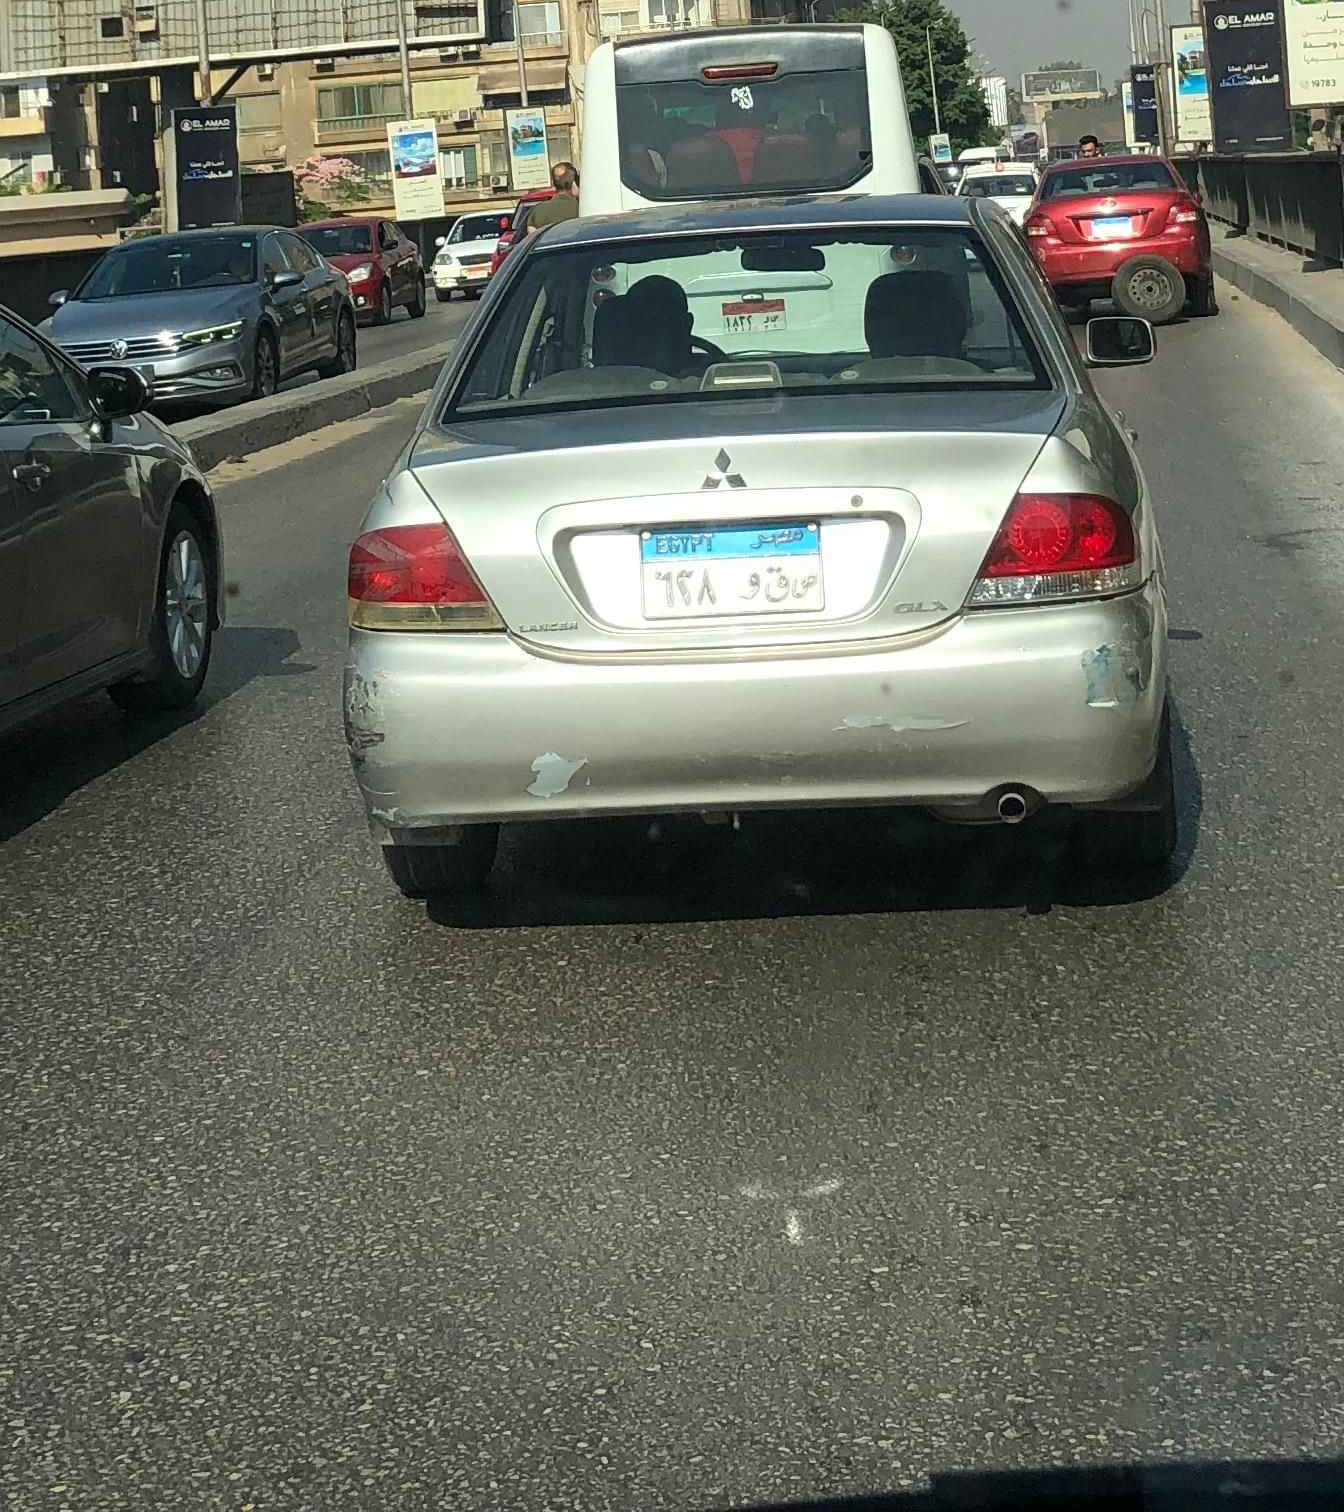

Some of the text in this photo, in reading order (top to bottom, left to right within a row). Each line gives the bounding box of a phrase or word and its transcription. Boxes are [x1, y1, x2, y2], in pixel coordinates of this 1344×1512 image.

[1228, 12, 1274, 24] EL AMAR
[655, 533, 715, 554] EGYPT
[893, 600, 948, 613] GLX
